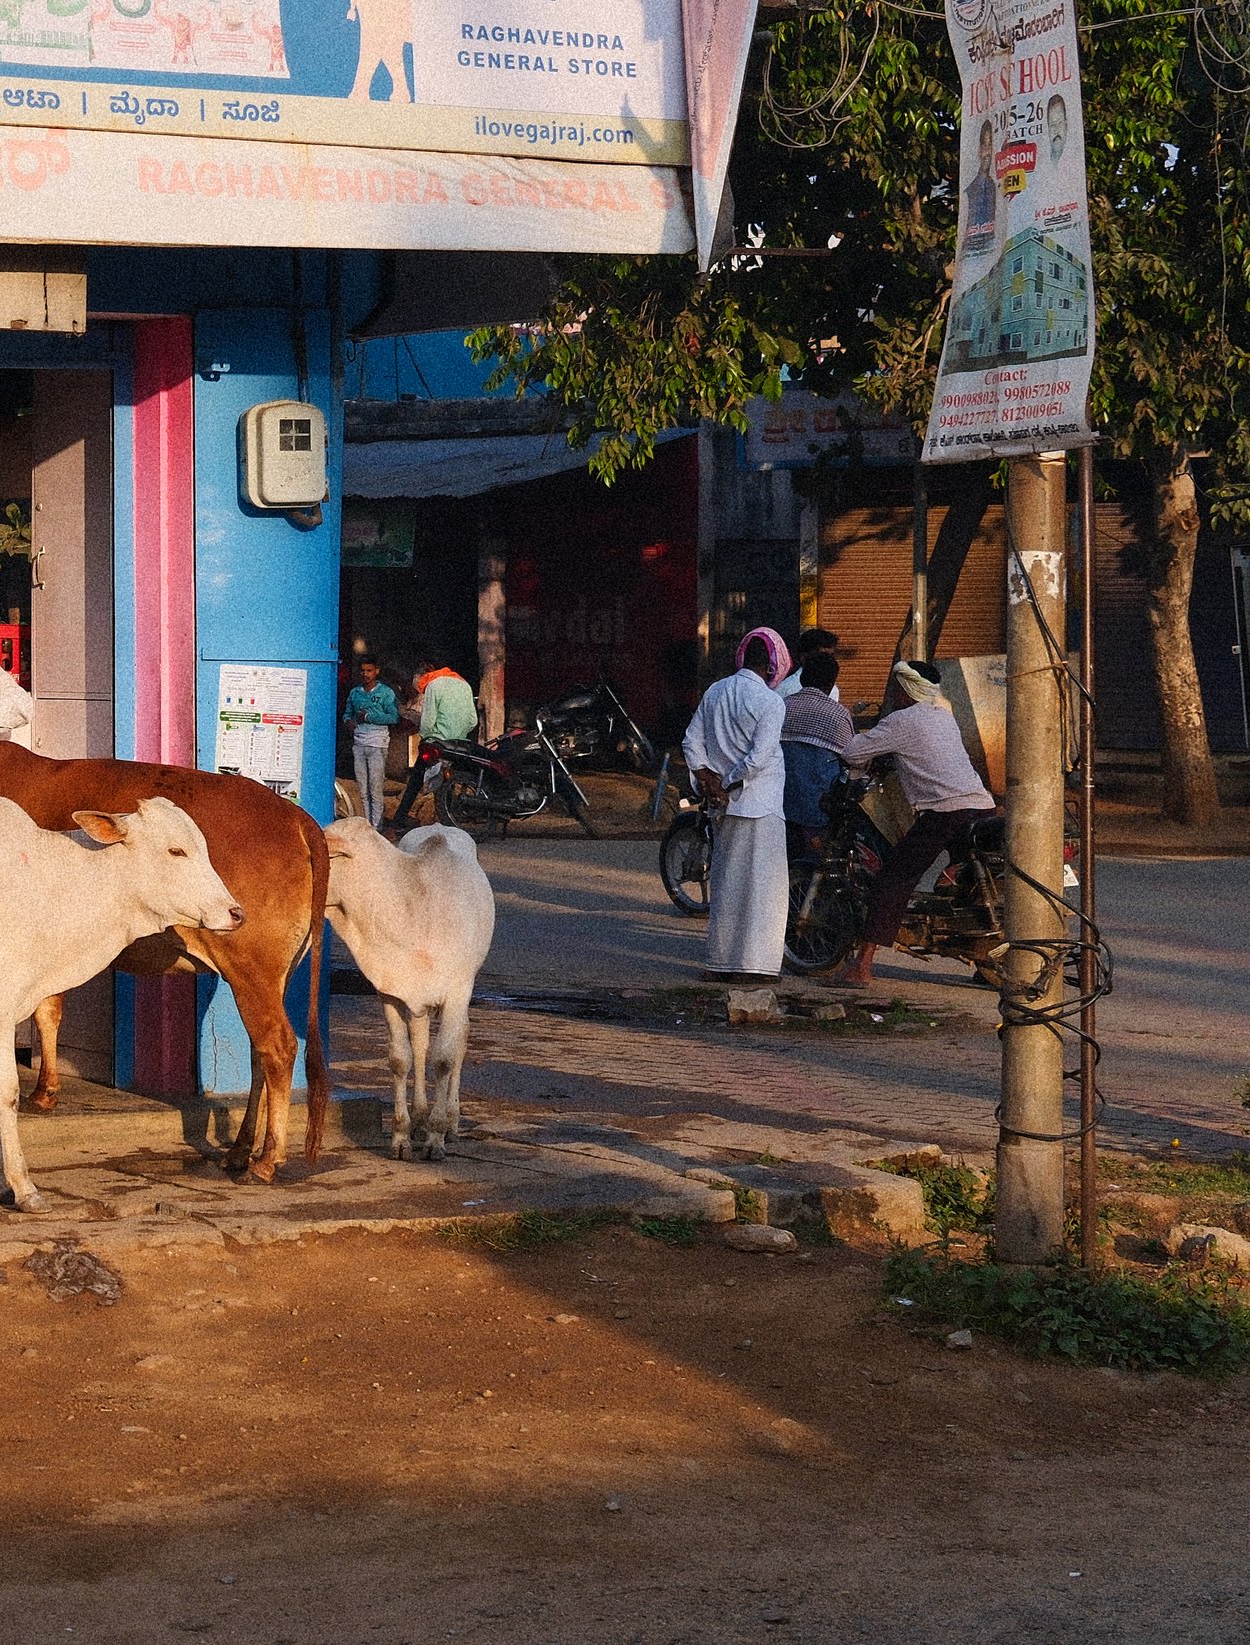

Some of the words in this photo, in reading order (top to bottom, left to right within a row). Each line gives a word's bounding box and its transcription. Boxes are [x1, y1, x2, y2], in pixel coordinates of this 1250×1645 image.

[461, 23, 625, 51] RAGHAVENDRA
[457, 50, 559, 73] GENERAL
[568, 58, 638, 78] STORE
[2, 88, 61, 111] ಆಟಾ
[109, 91, 180, 125] ಮೈದಾ
[221, 100, 281, 123] ಸೂಜಿ
[474, 115, 635, 146] ilovegajraj.com
[137, 156, 448, 206] RAGHAVENDRA
[461, 171, 641, 212] GENERAL
